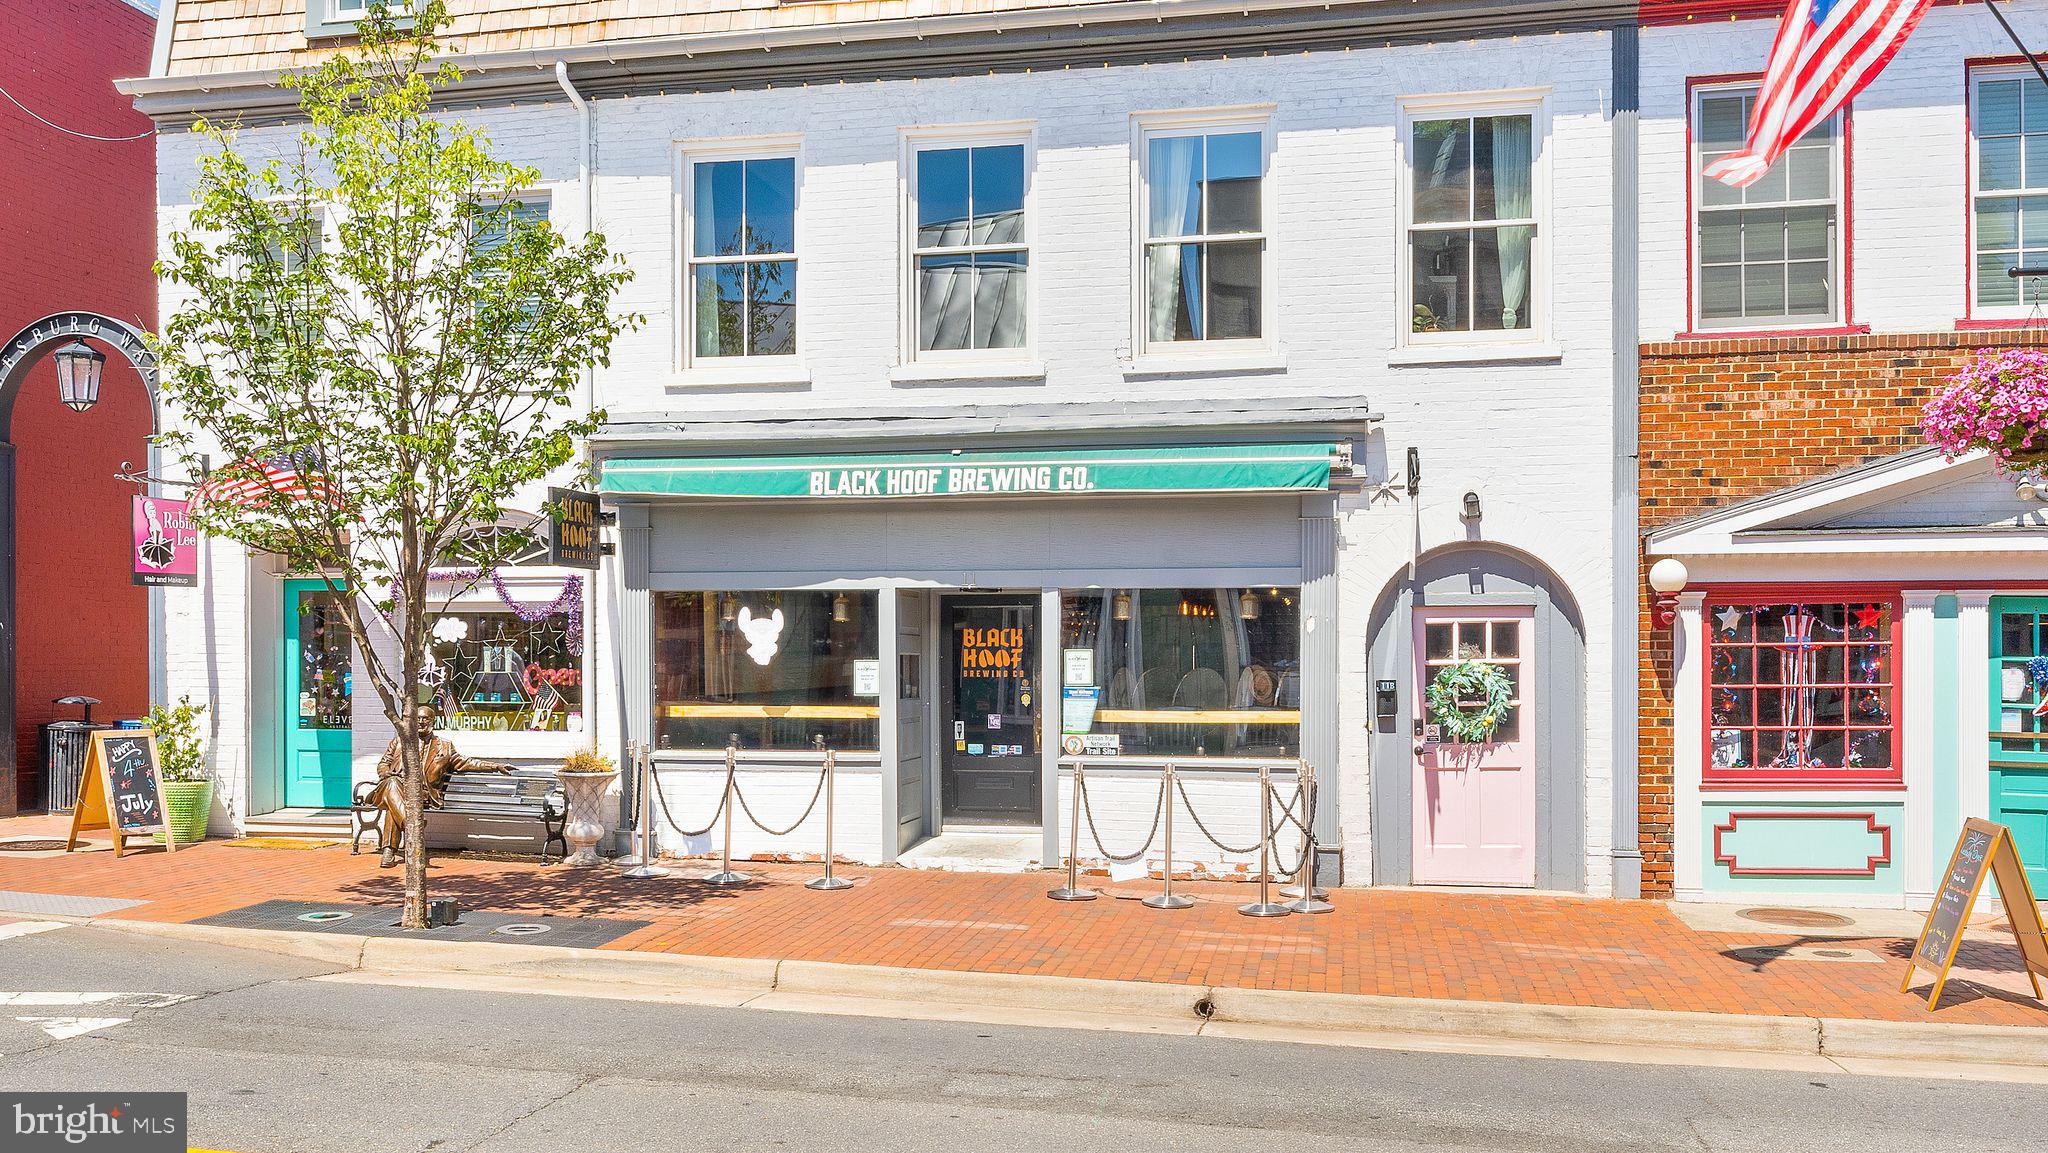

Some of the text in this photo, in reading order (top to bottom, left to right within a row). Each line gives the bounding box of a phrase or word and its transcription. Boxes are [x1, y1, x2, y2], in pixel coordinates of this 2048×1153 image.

[0, 315, 101, 387] ESBURG
[809, 466, 1094, 496] BLACK HOOF BREWING CO.
[163, 511, 196, 530] Robin
[561, 497, 592, 526] BLACK
[177, 529, 196, 546] Lee
[561, 522, 592, 550] HOOF
[144, 575, 156, 583] Hair
[156, 576, 167, 584] and
[963, 627, 1023, 648] BLACK
[963, 648, 1023, 670] HOOF
[963, 669, 1025, 678] BREWING CO
[111, 739, 136, 757] HAPPY
[1086, 747, 1117, 755] Trail Site
[119, 793, 153, 815] July
